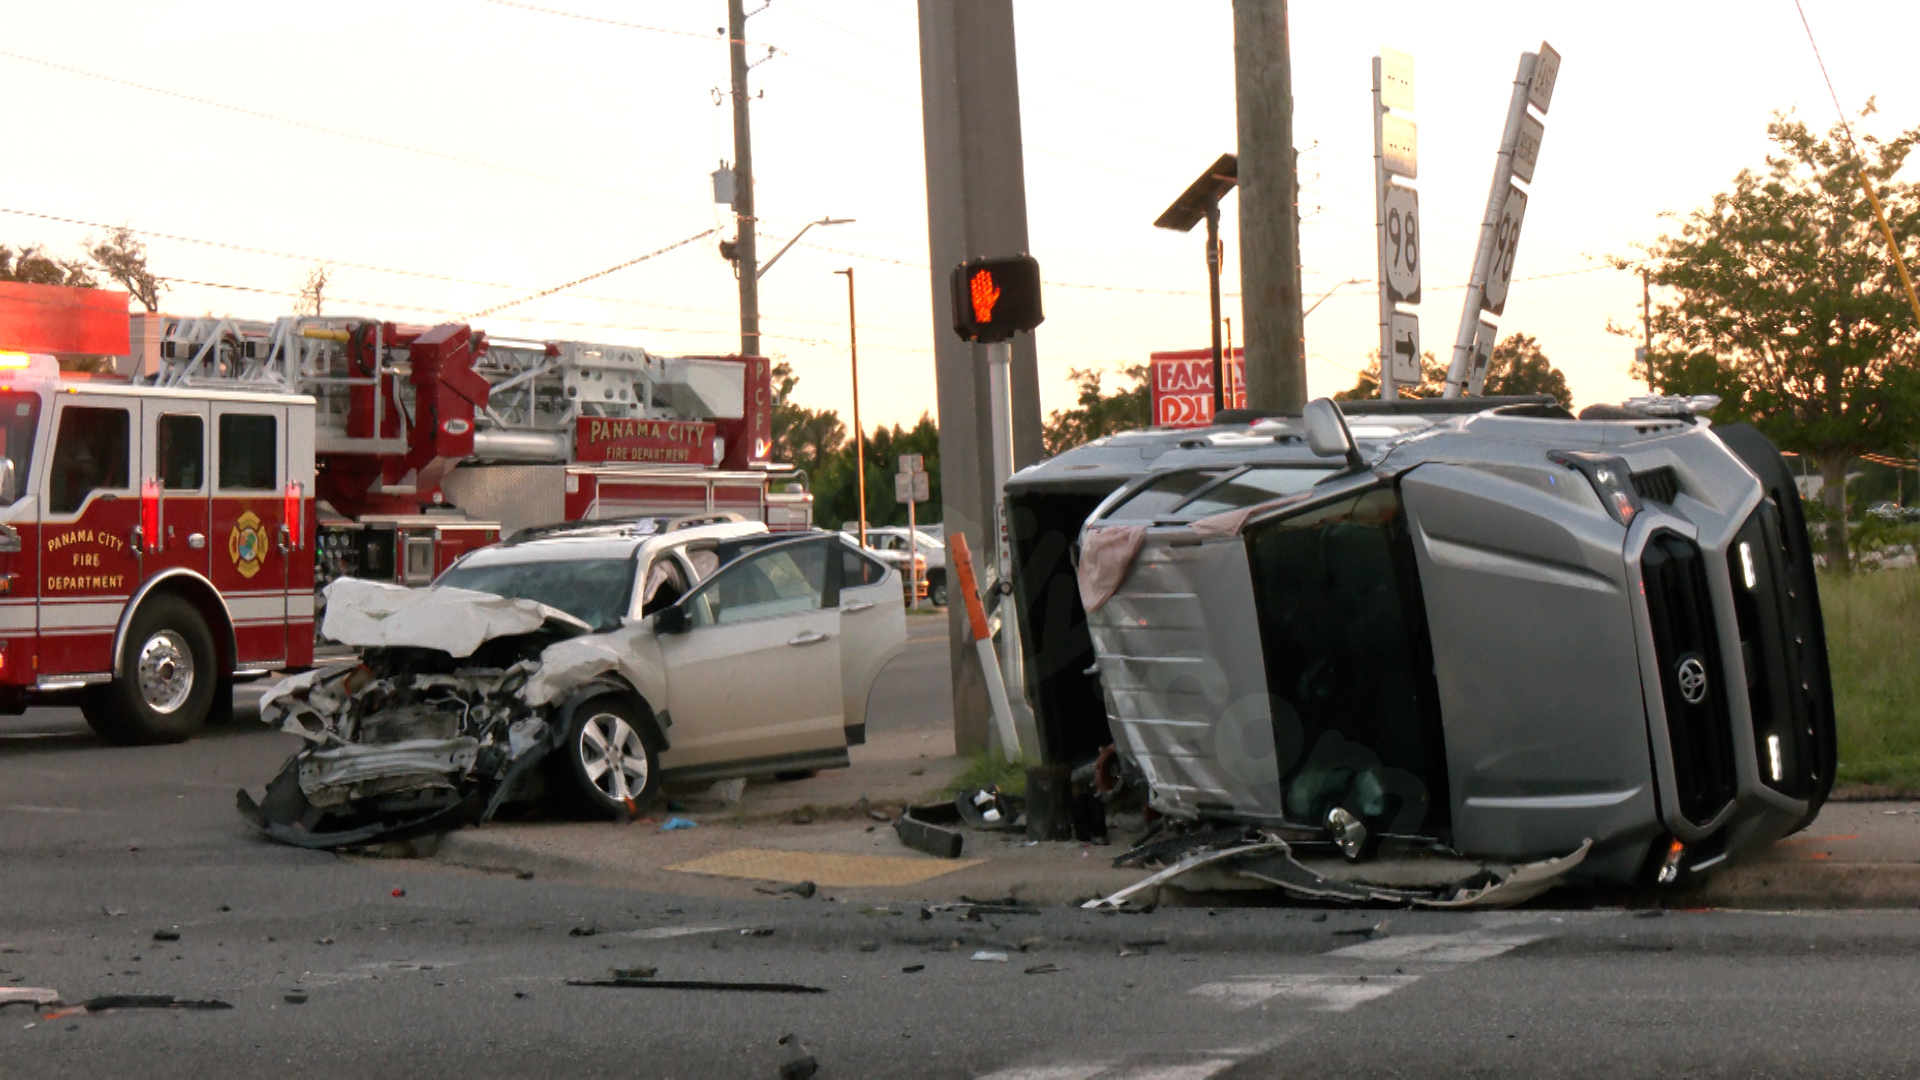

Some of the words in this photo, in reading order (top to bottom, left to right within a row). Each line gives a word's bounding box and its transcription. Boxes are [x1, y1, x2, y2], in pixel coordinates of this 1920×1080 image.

[1389, 207, 1417, 276] 98
[1493, 212, 1519, 282] 98
[591, 420, 660, 443] PANAMA
[667, 423, 705, 447] CITY
[606, 445, 627, 460] FIRE
[632, 447, 689, 461] DEPARTMENT
[47, 529, 93, 552] PANAMA
[98, 531, 124, 552] CITY
[73, 553, 100, 567] FIRE
[48, 575, 124, 590] DEPARTMENT
